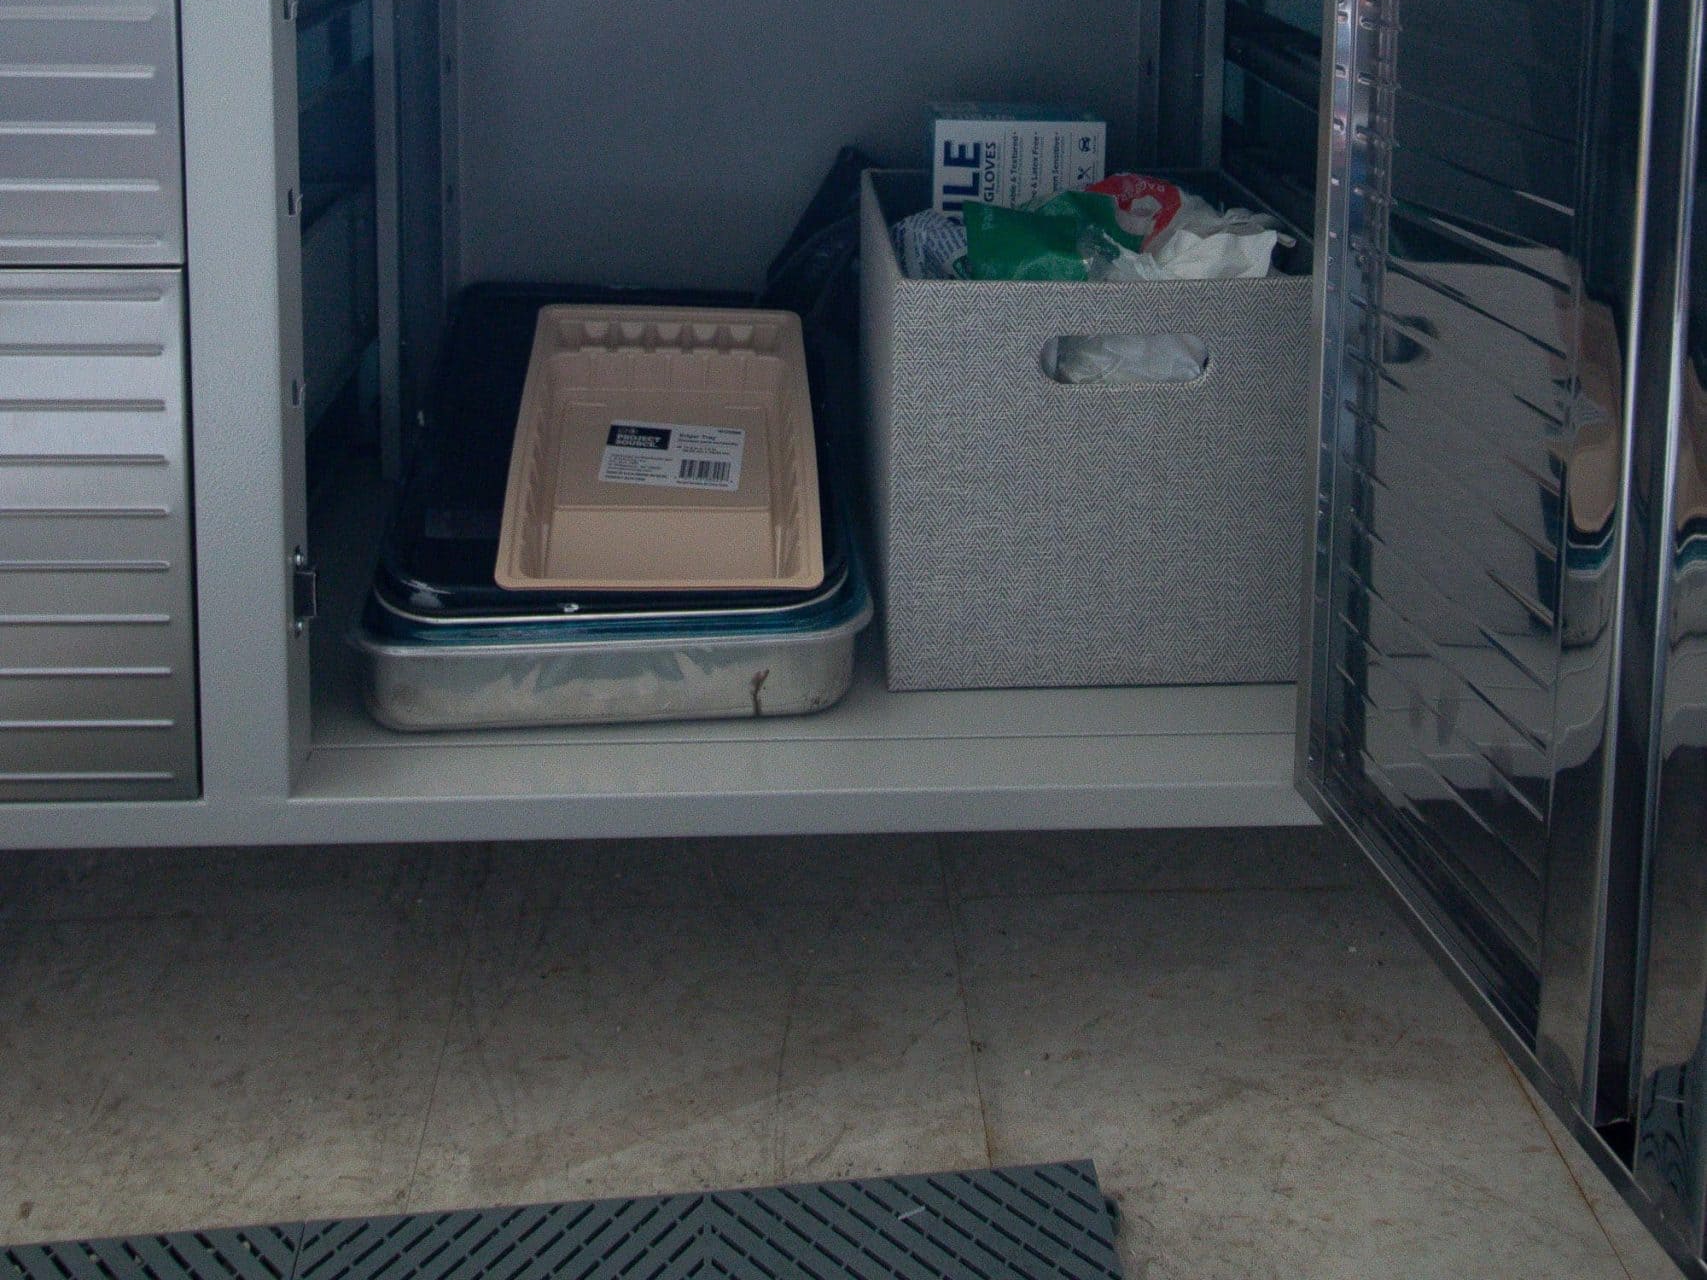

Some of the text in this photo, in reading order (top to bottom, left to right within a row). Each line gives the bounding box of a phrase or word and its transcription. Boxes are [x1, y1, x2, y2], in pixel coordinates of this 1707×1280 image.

[1010, 136, 1018, 175] Textured
[1031, 136, 1039, 155] Free
[1052, 136, 1060, 174] Sensitive
[983, 142, 996, 203] GLOVES
